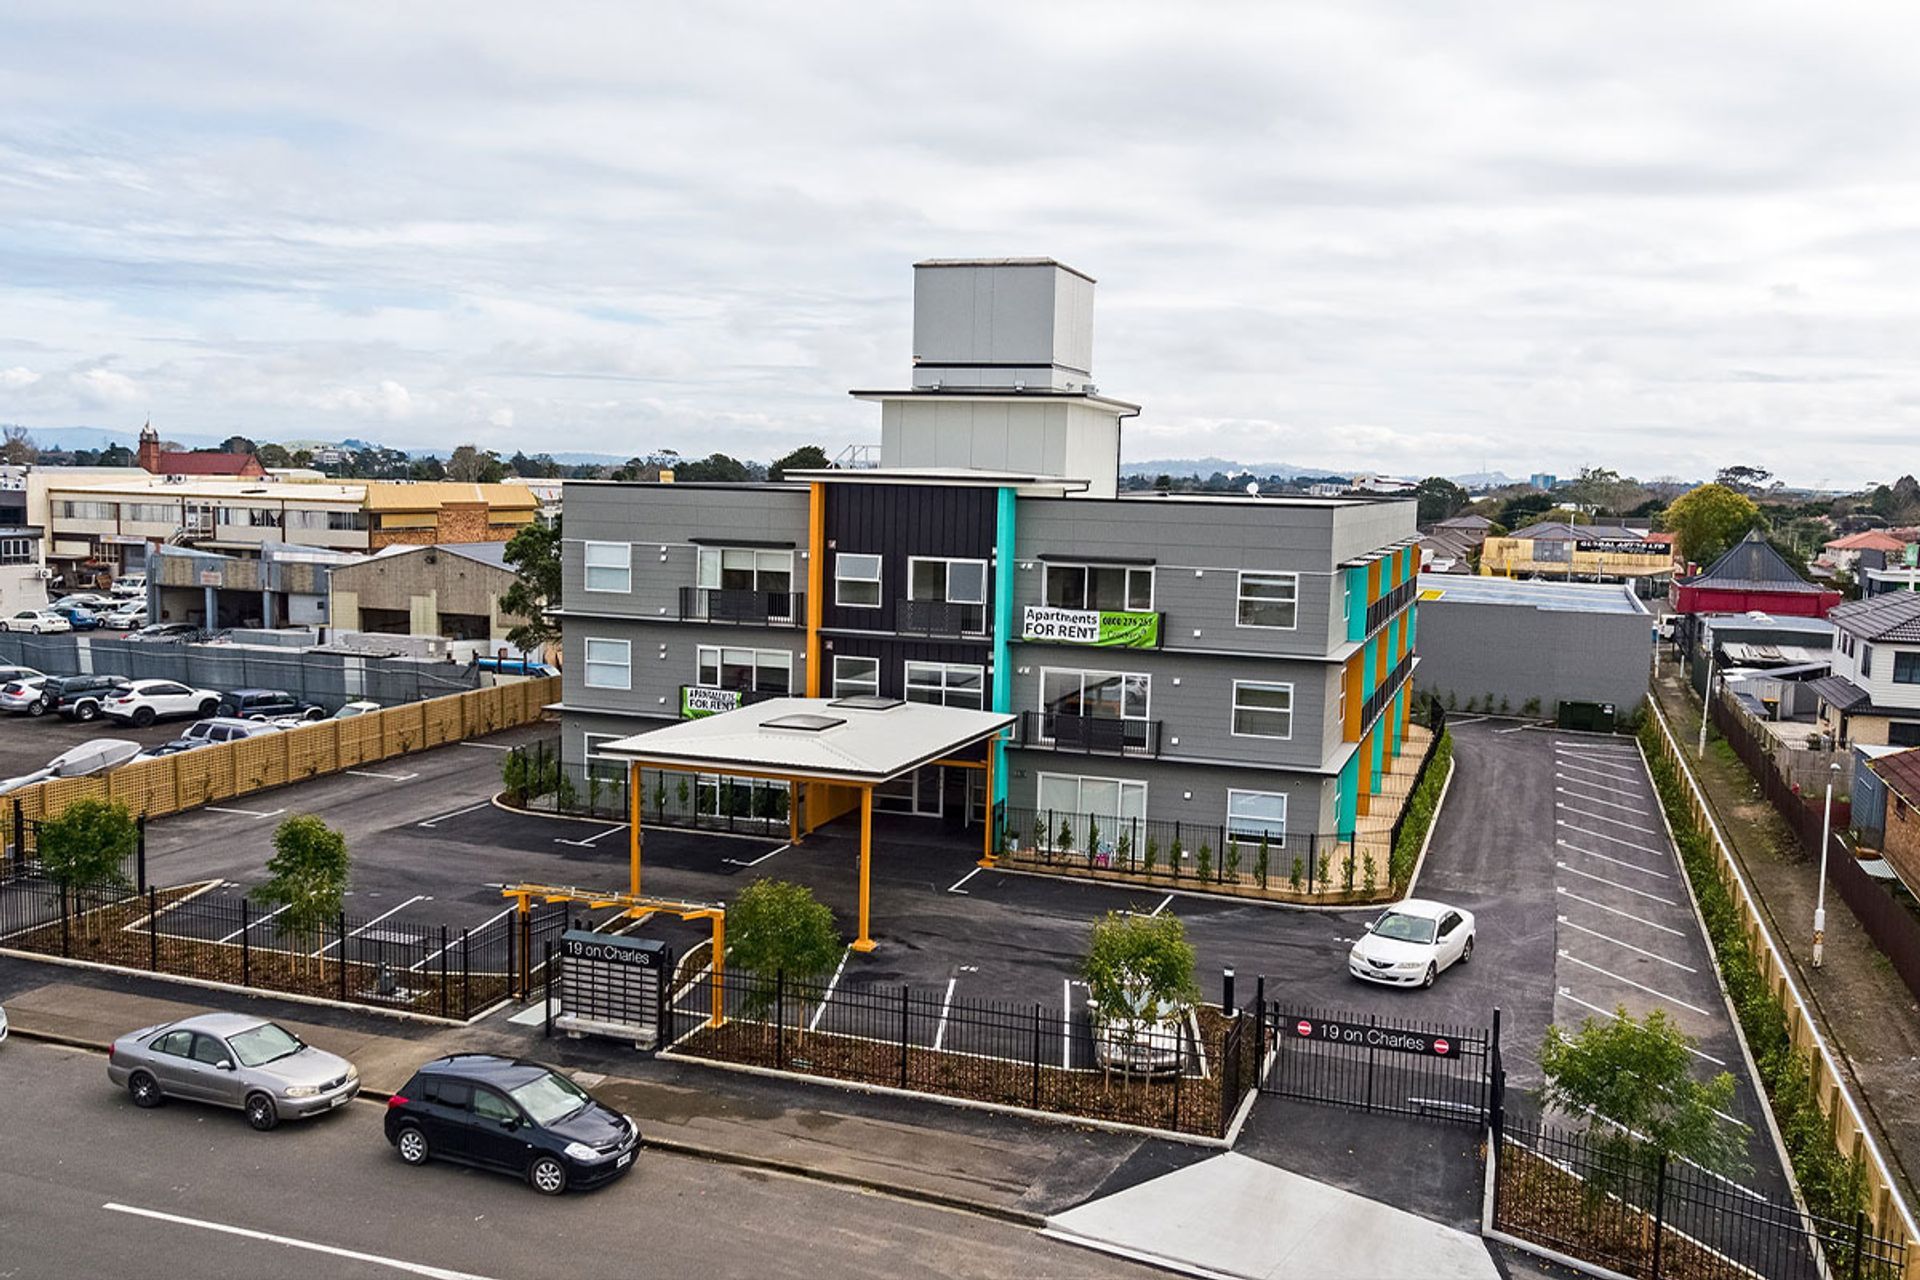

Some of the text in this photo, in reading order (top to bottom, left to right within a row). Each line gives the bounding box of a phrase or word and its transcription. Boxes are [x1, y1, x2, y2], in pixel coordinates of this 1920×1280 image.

[1026, 609, 1097, 625] Apartments
[1025, 623, 1097, 639] FOR RENT
[690, 699, 735, 711] FOR RENT
[567, 941, 650, 964] 19 on Charles
[1320, 1024, 1425, 1051] 19 on Charles
